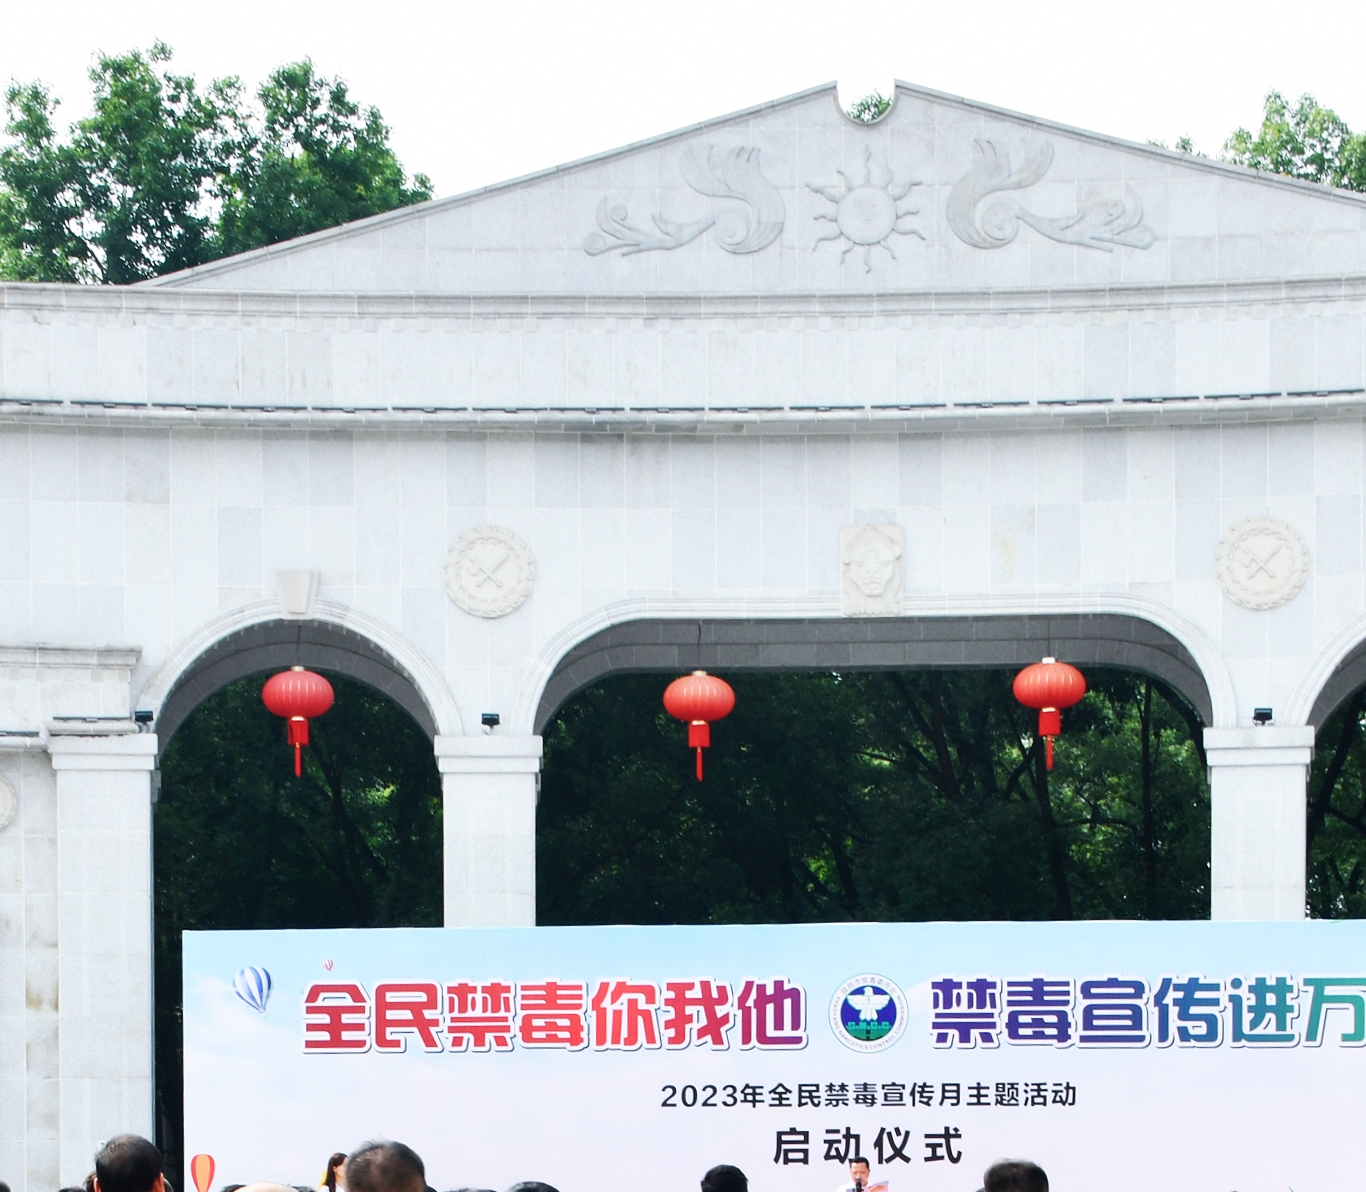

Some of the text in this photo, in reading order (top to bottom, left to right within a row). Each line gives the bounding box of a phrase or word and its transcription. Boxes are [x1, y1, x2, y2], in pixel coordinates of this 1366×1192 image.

[303, 980, 805, 1051] 全民禁毒你我他
[661, 1082, 1077, 1108] 2023年全民禁毒宣传月主题活动
[773, 1126, 963, 1165] 启动仪式
